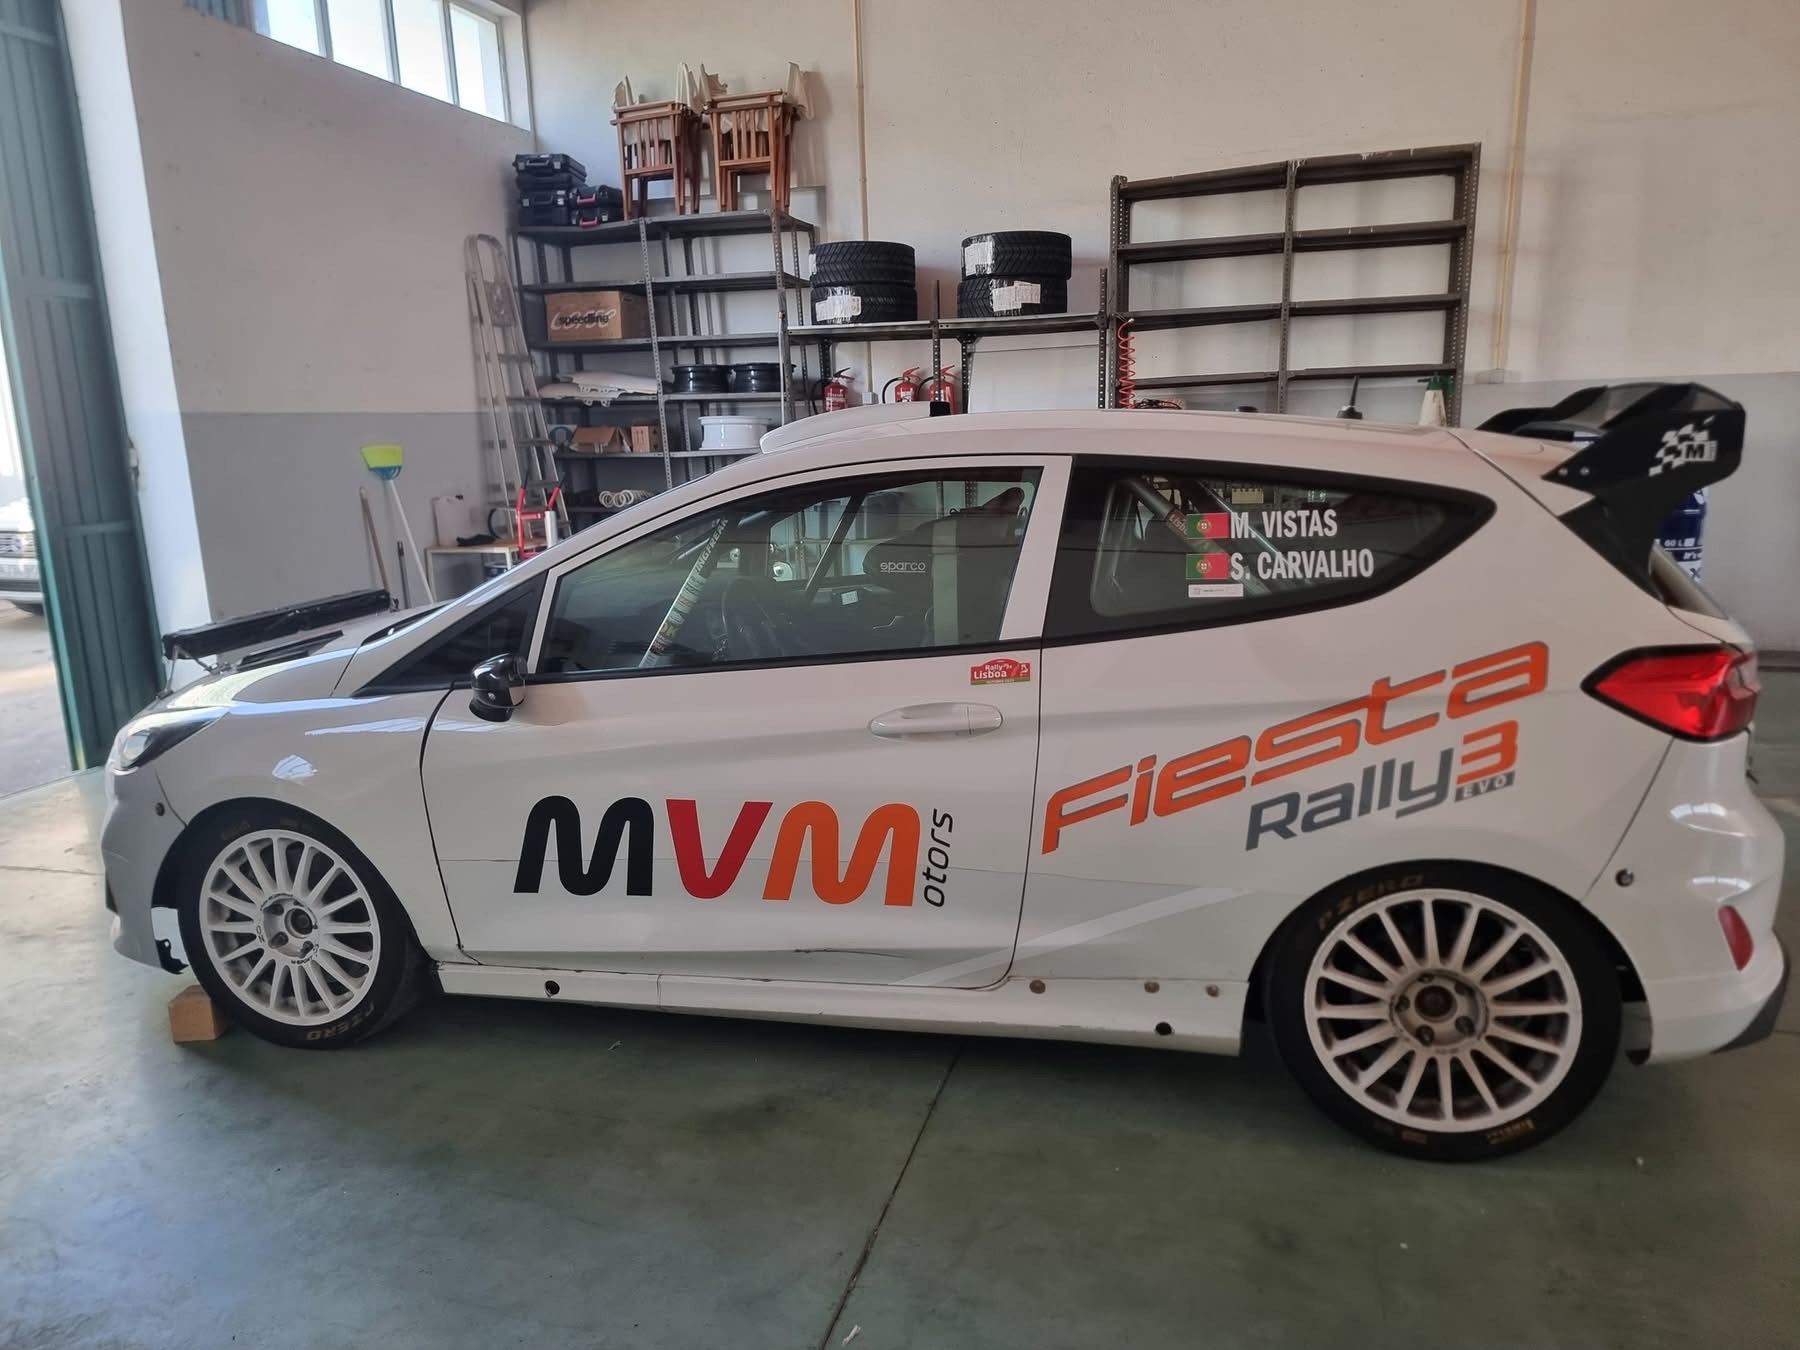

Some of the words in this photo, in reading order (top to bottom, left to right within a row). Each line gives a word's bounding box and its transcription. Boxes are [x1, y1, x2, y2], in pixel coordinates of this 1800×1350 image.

[1230, 512, 1256, 539] M.
[1262, 509, 1338, 538] VISTAS
[880, 561, 926, 574] sparco
[1230, 551, 1251, 580] S.
[1257, 548, 1375, 580] CARVALHO
[973, 670, 1008, 680] Lisboa
[1042, 640, 1549, 854] Fiesta
[1460, 774, 1510, 799] EVO
[514, 795, 921, 907] MVM
[922, 807, 955, 908] otors
